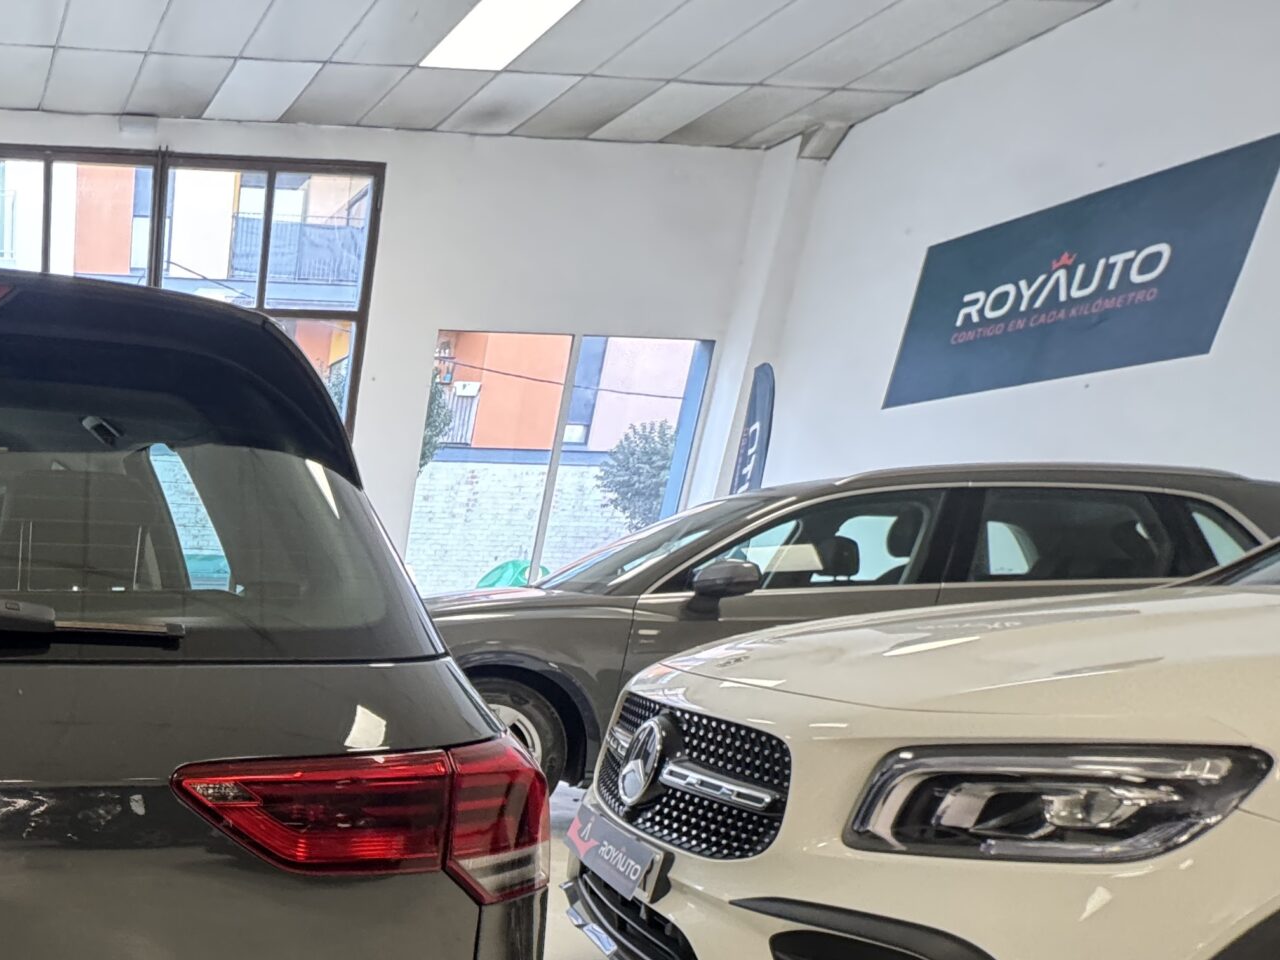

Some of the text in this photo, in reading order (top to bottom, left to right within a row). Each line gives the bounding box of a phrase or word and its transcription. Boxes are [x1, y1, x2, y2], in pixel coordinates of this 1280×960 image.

[955, 242, 1172, 327] ROYAUTO
[950, 287, 1159, 344] CONTIGO EN CADA KILÓMETRO
[598, 840, 641, 881] ROYAUTO
